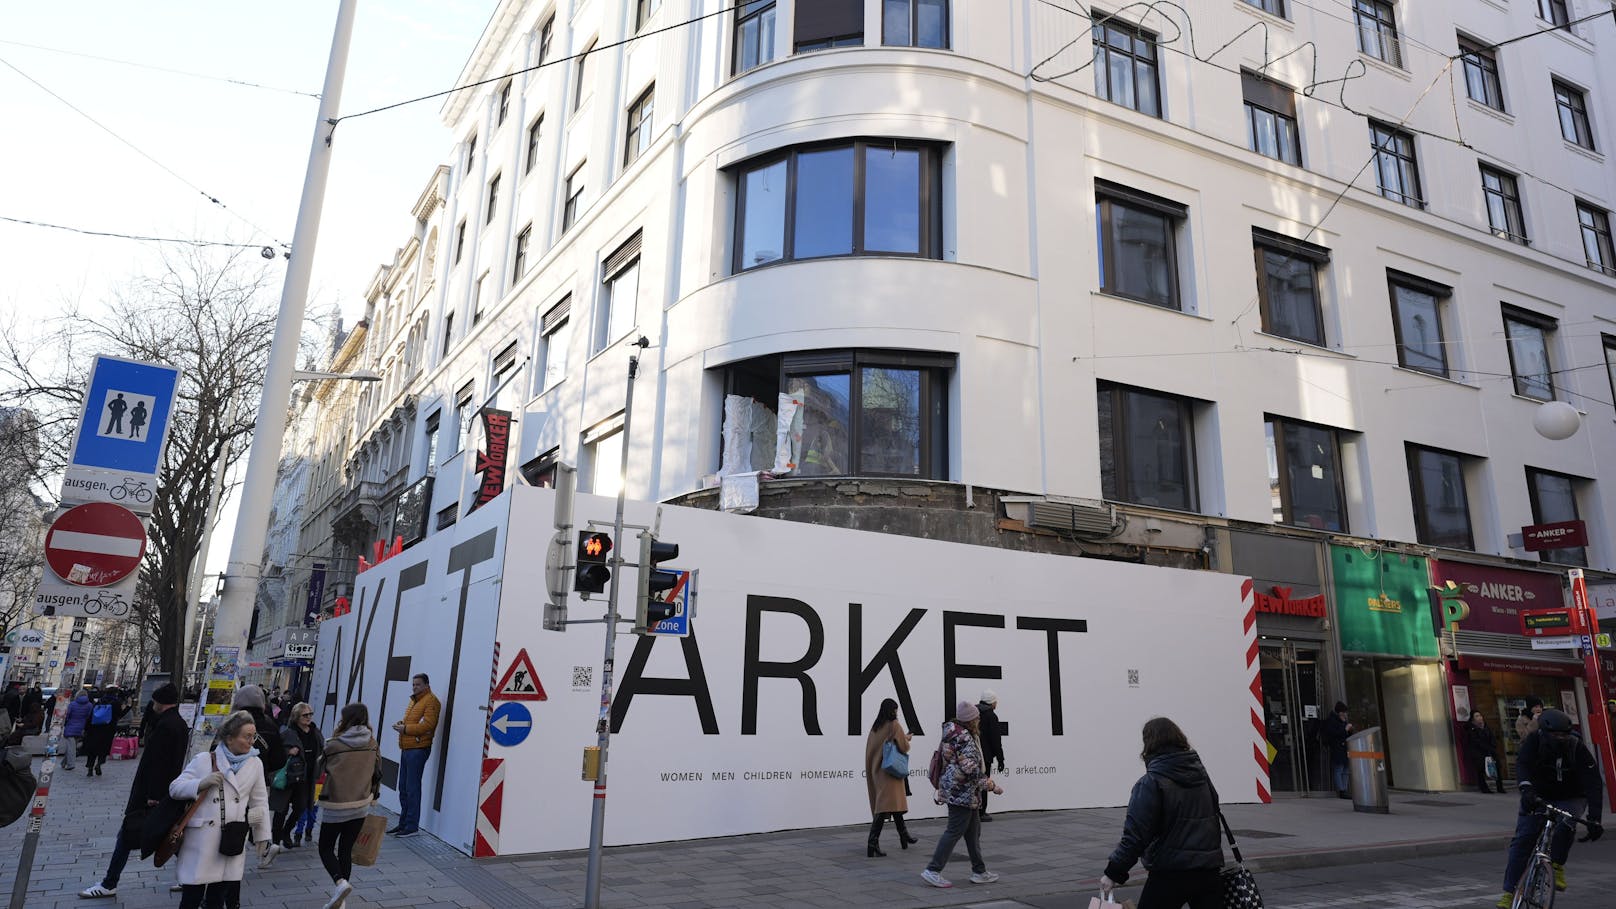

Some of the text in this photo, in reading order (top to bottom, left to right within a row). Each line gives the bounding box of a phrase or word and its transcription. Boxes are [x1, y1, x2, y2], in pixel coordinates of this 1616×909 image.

[65, 478, 110, 491] ausgen.
[1536, 528, 1566, 538] ANKER
[1480, 582, 1524, 601] ANKER
[37, 593, 84, 606] ausgen.
[21, 634, 40, 643] ÖGK
[288, 644, 313, 653] tiger
[610, 593, 1088, 736] ARKET
[660, 772, 702, 782] WOMEN
[711, 771, 735, 781] MEN
[743, 771, 792, 780] CHILDREN
[800, 770, 854, 779] HOMEWARE
[1015, 765, 1057, 775] arket.com
